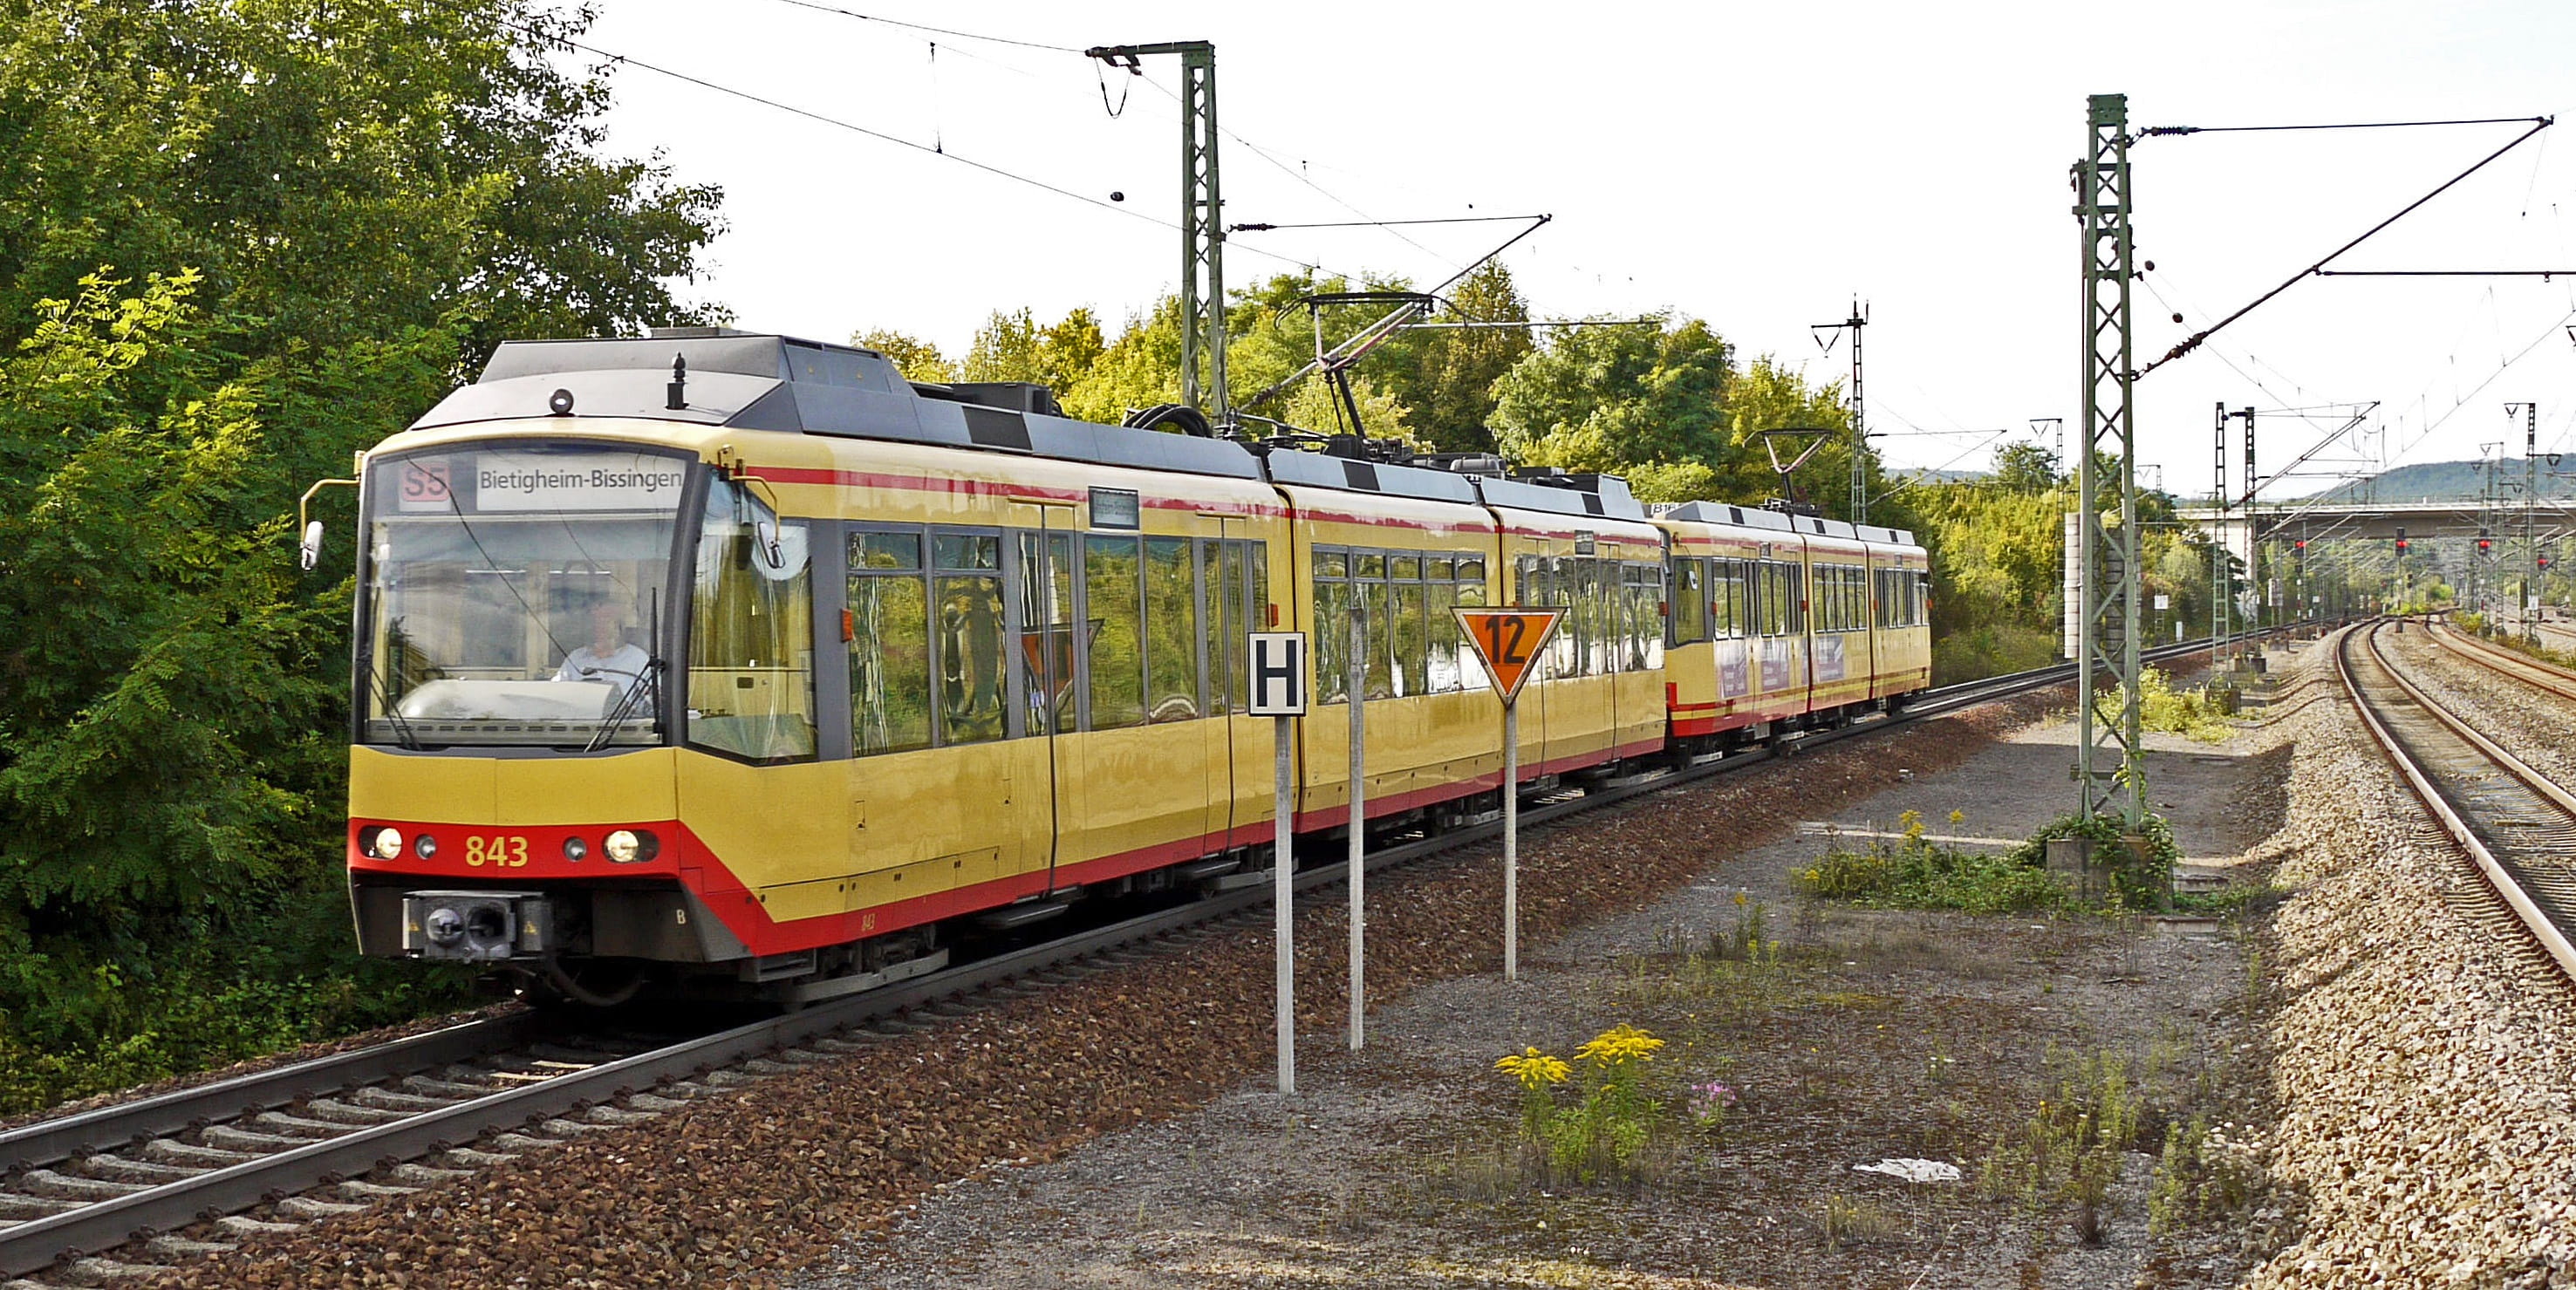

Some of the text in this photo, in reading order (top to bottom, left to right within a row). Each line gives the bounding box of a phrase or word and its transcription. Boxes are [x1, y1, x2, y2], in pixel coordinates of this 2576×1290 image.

[405, 467, 682, 496] S5 Bietigheim-Bissingen
[1485, 614, 1526, 665] 12
[1256, 639, 1297, 707] H
[465, 836, 529, 867] 843
[676, 909, 687, 925] B
